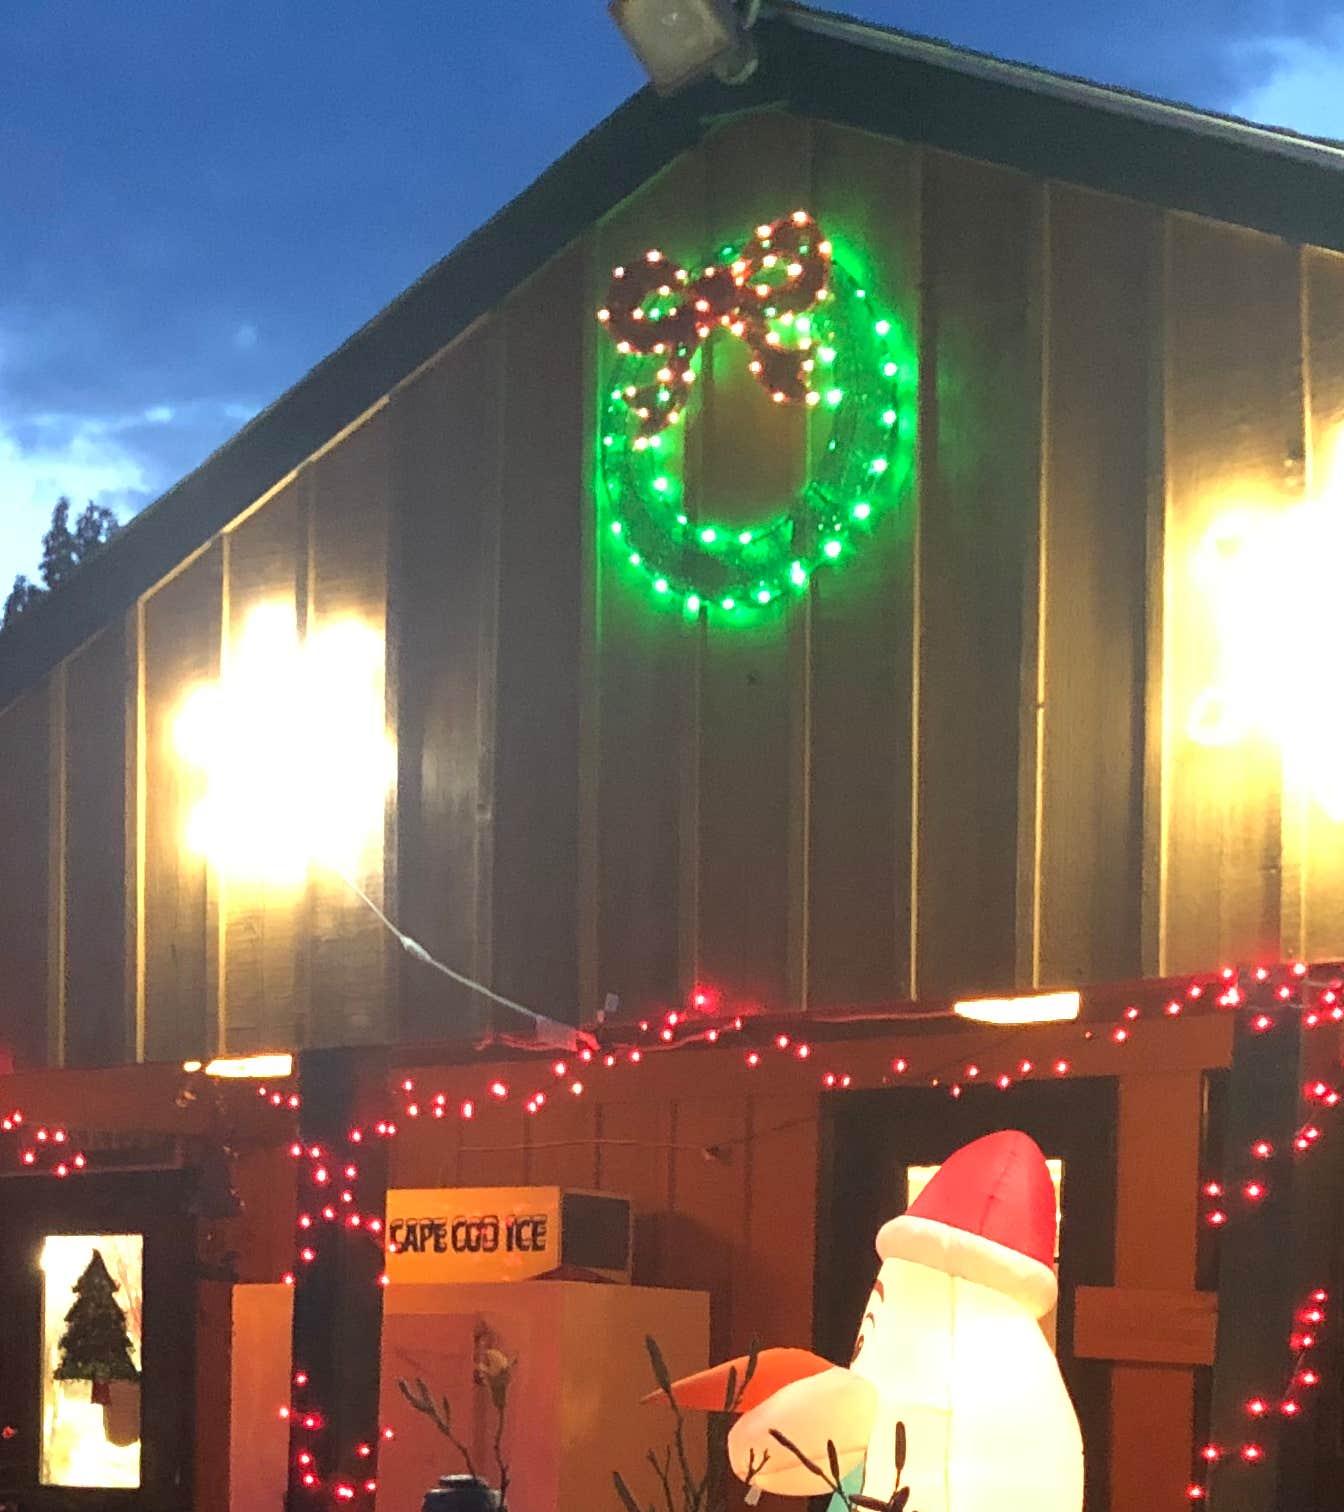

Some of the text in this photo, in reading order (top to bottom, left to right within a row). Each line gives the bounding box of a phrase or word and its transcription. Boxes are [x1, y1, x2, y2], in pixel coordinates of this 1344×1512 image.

[389, 1214, 548, 1254] CAPE COD ICE
